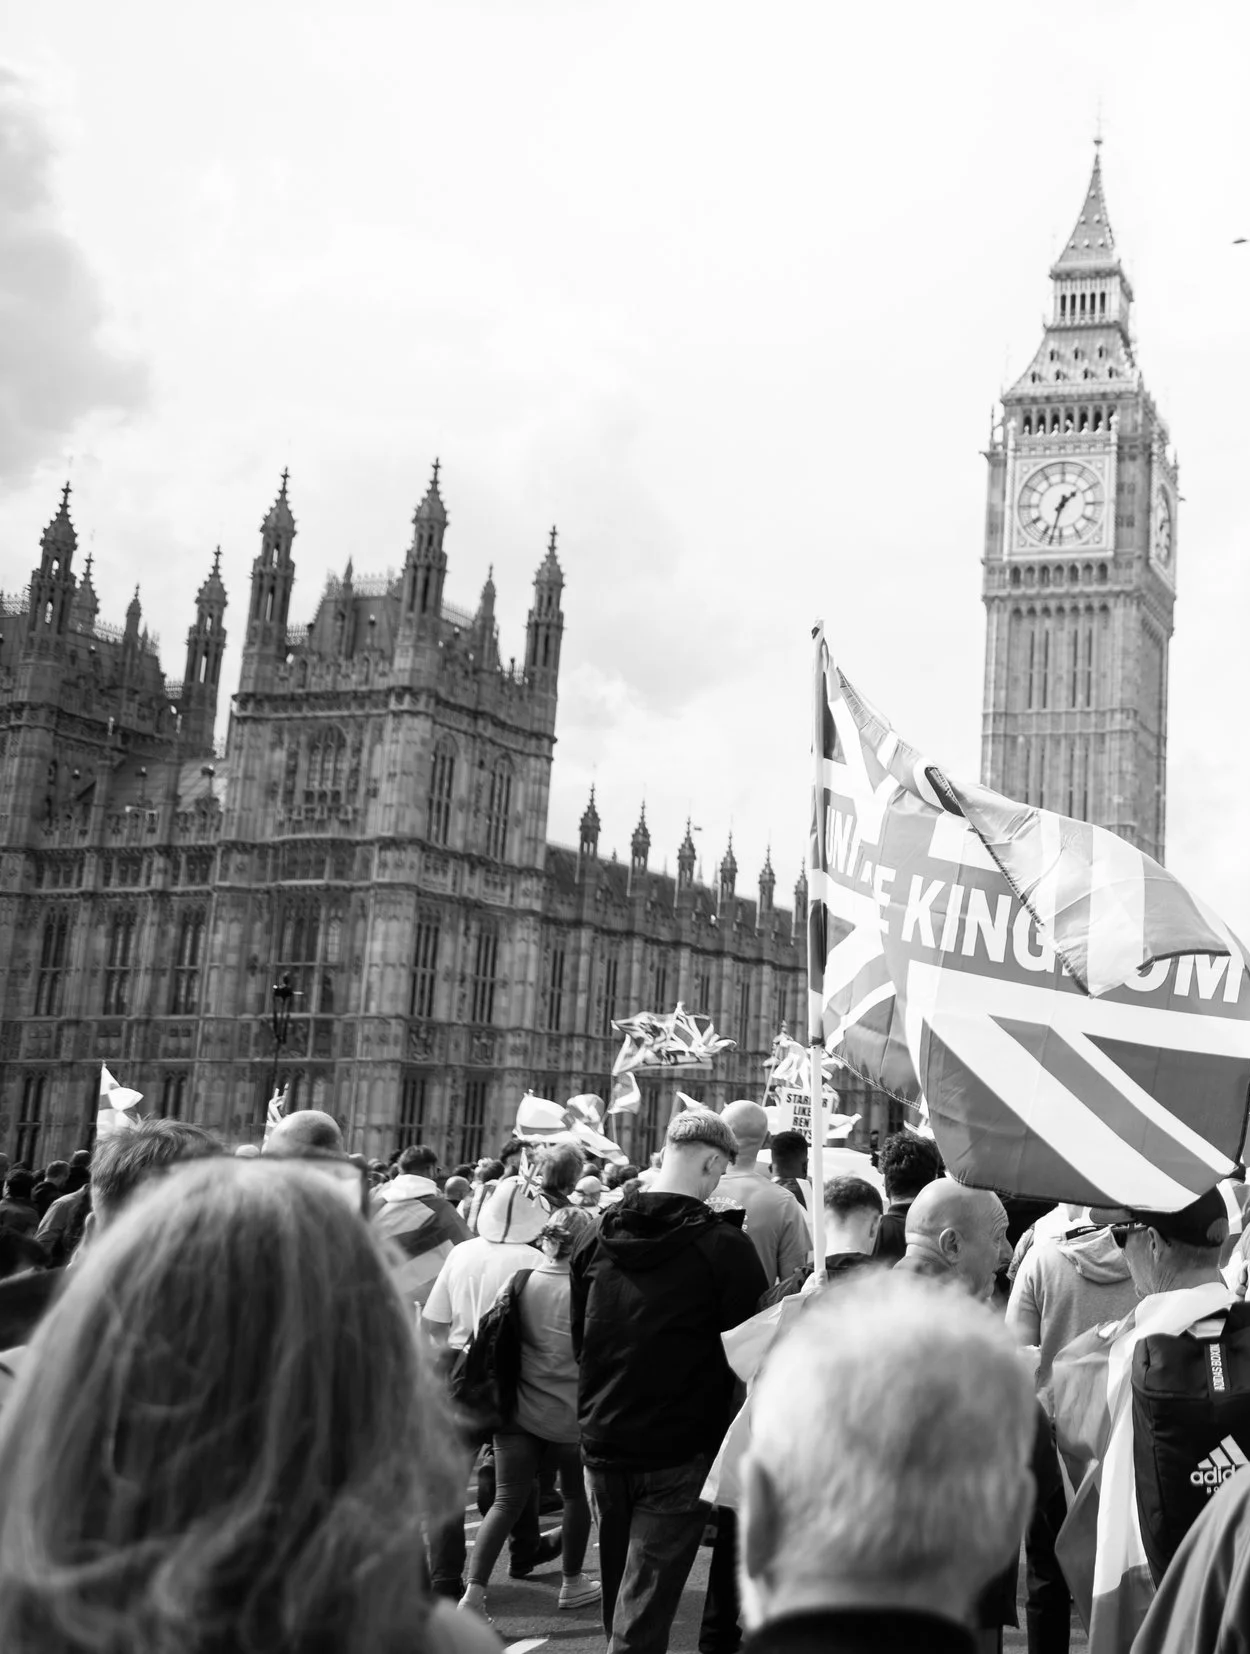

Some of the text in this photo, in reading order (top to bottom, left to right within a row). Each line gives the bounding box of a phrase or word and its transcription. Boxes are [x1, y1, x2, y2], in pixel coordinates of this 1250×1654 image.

[901, 873, 1245, 1003] KINGM
[786, 1093, 829, 1109] STARR
[1189, 1464, 1236, 1488] adid
